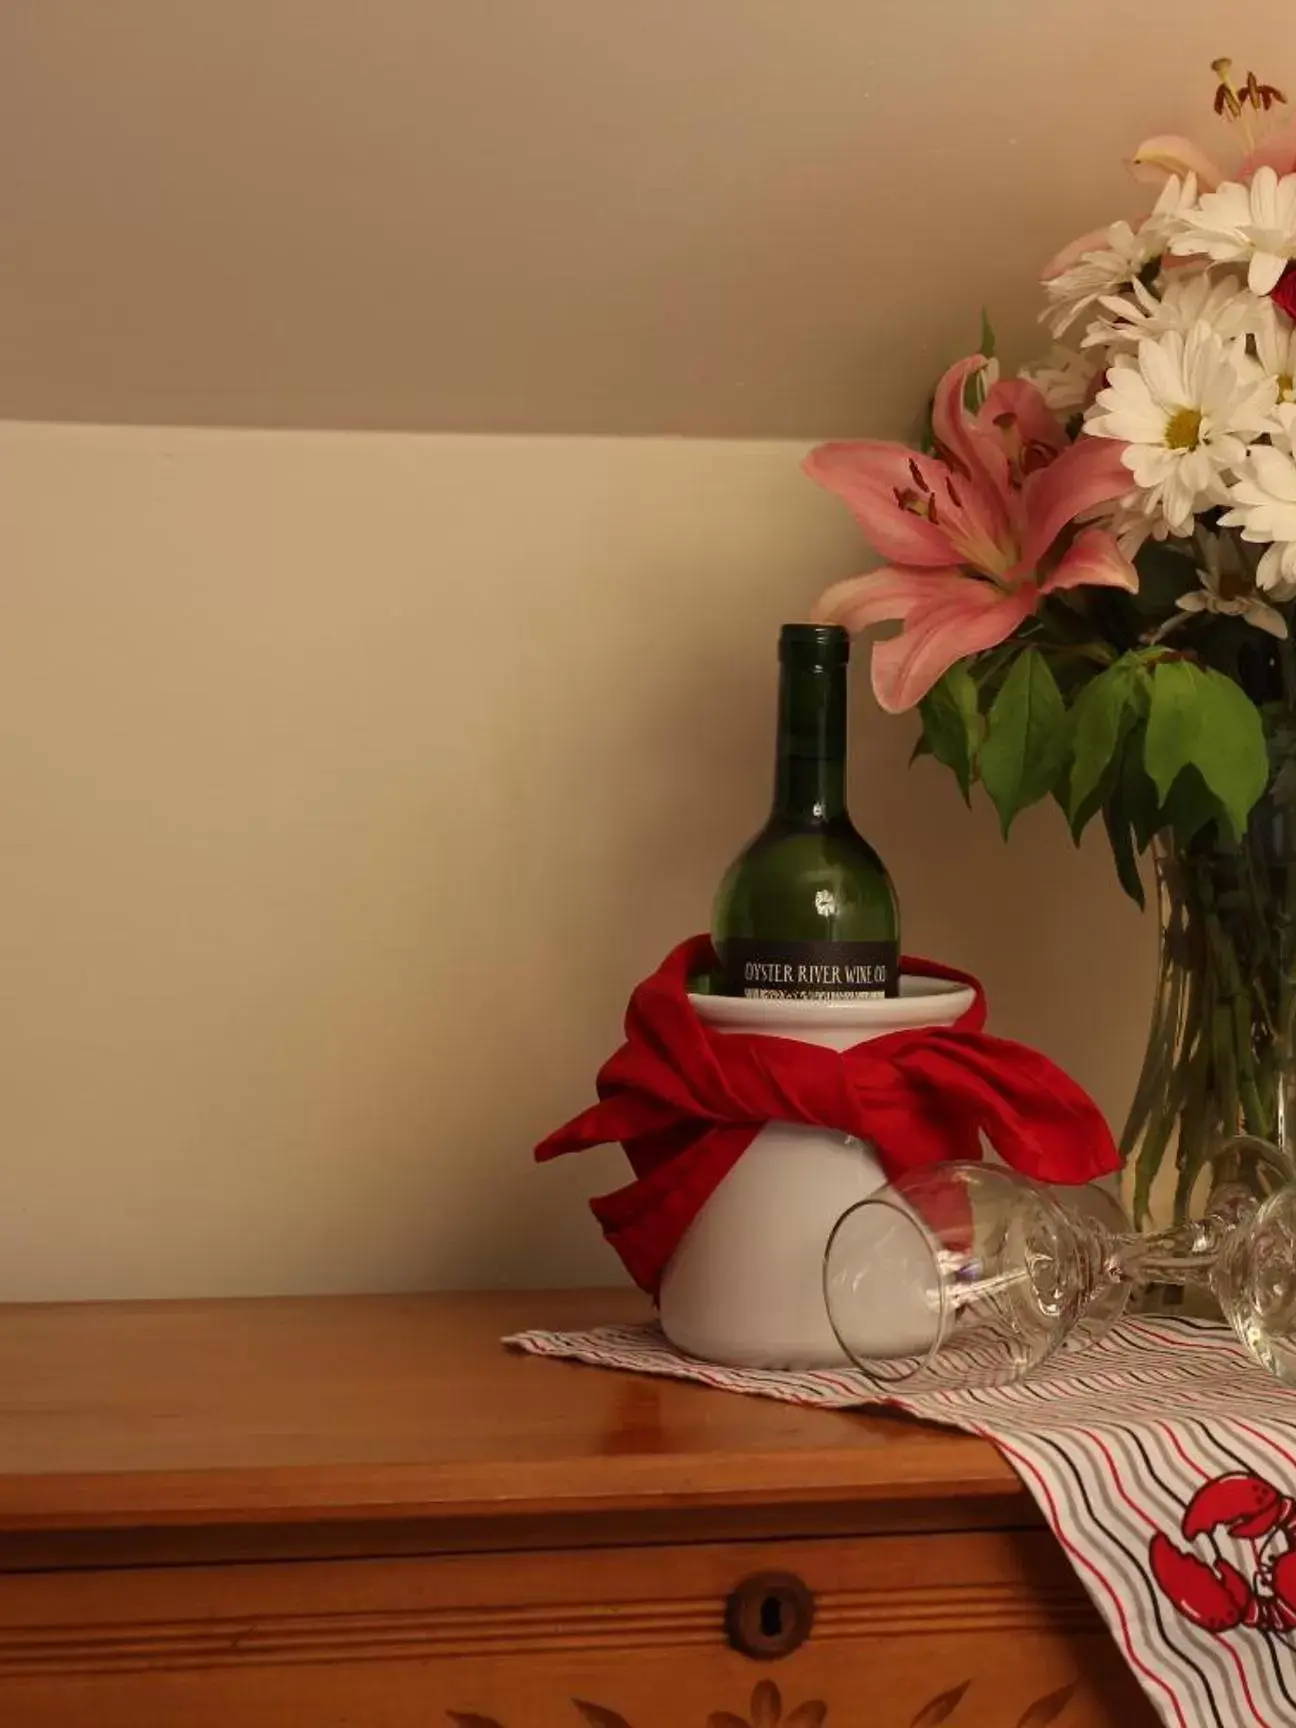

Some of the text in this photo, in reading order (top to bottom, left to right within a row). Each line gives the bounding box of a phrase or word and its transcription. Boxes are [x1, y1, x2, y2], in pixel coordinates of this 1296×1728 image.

[745, 961, 794, 982] OYSTER
[798, 965, 842, 984] RIVER
[844, 965, 872, 984] WINE
